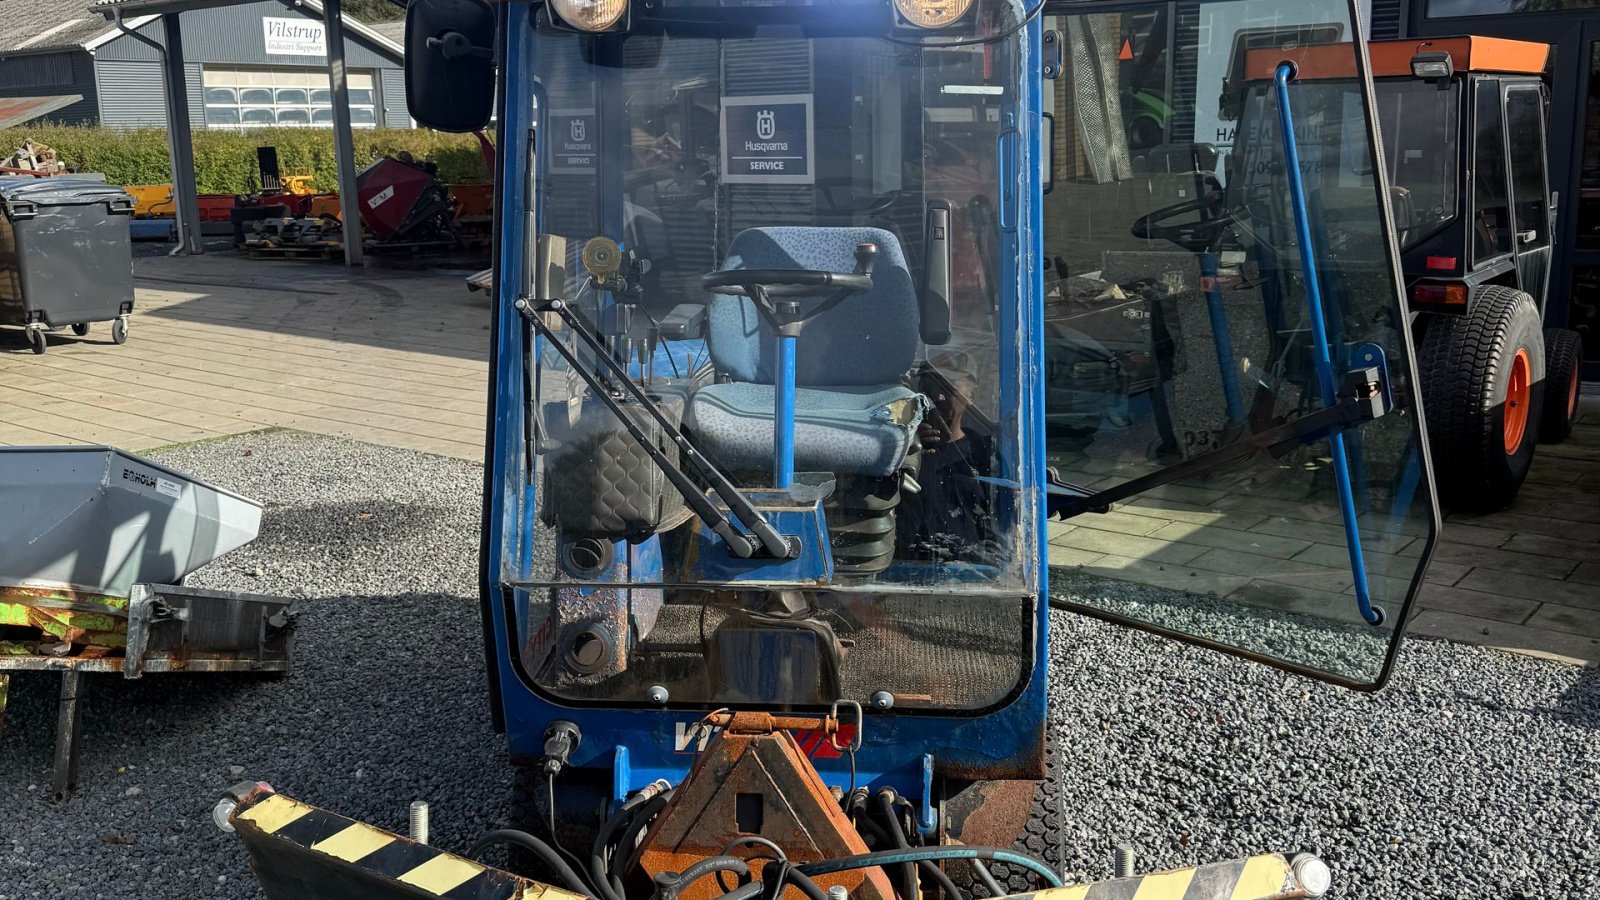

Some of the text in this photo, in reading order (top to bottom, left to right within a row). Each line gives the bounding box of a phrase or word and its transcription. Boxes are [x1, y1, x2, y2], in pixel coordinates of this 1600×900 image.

[267, 21, 322, 43] Vilstrup
[267, 41, 322, 53] Industri Support
[745, 141, 788, 152] Husqvarna
[750, 161, 784, 170] SERVICE
[122, 468, 157, 489] EGHOLM
